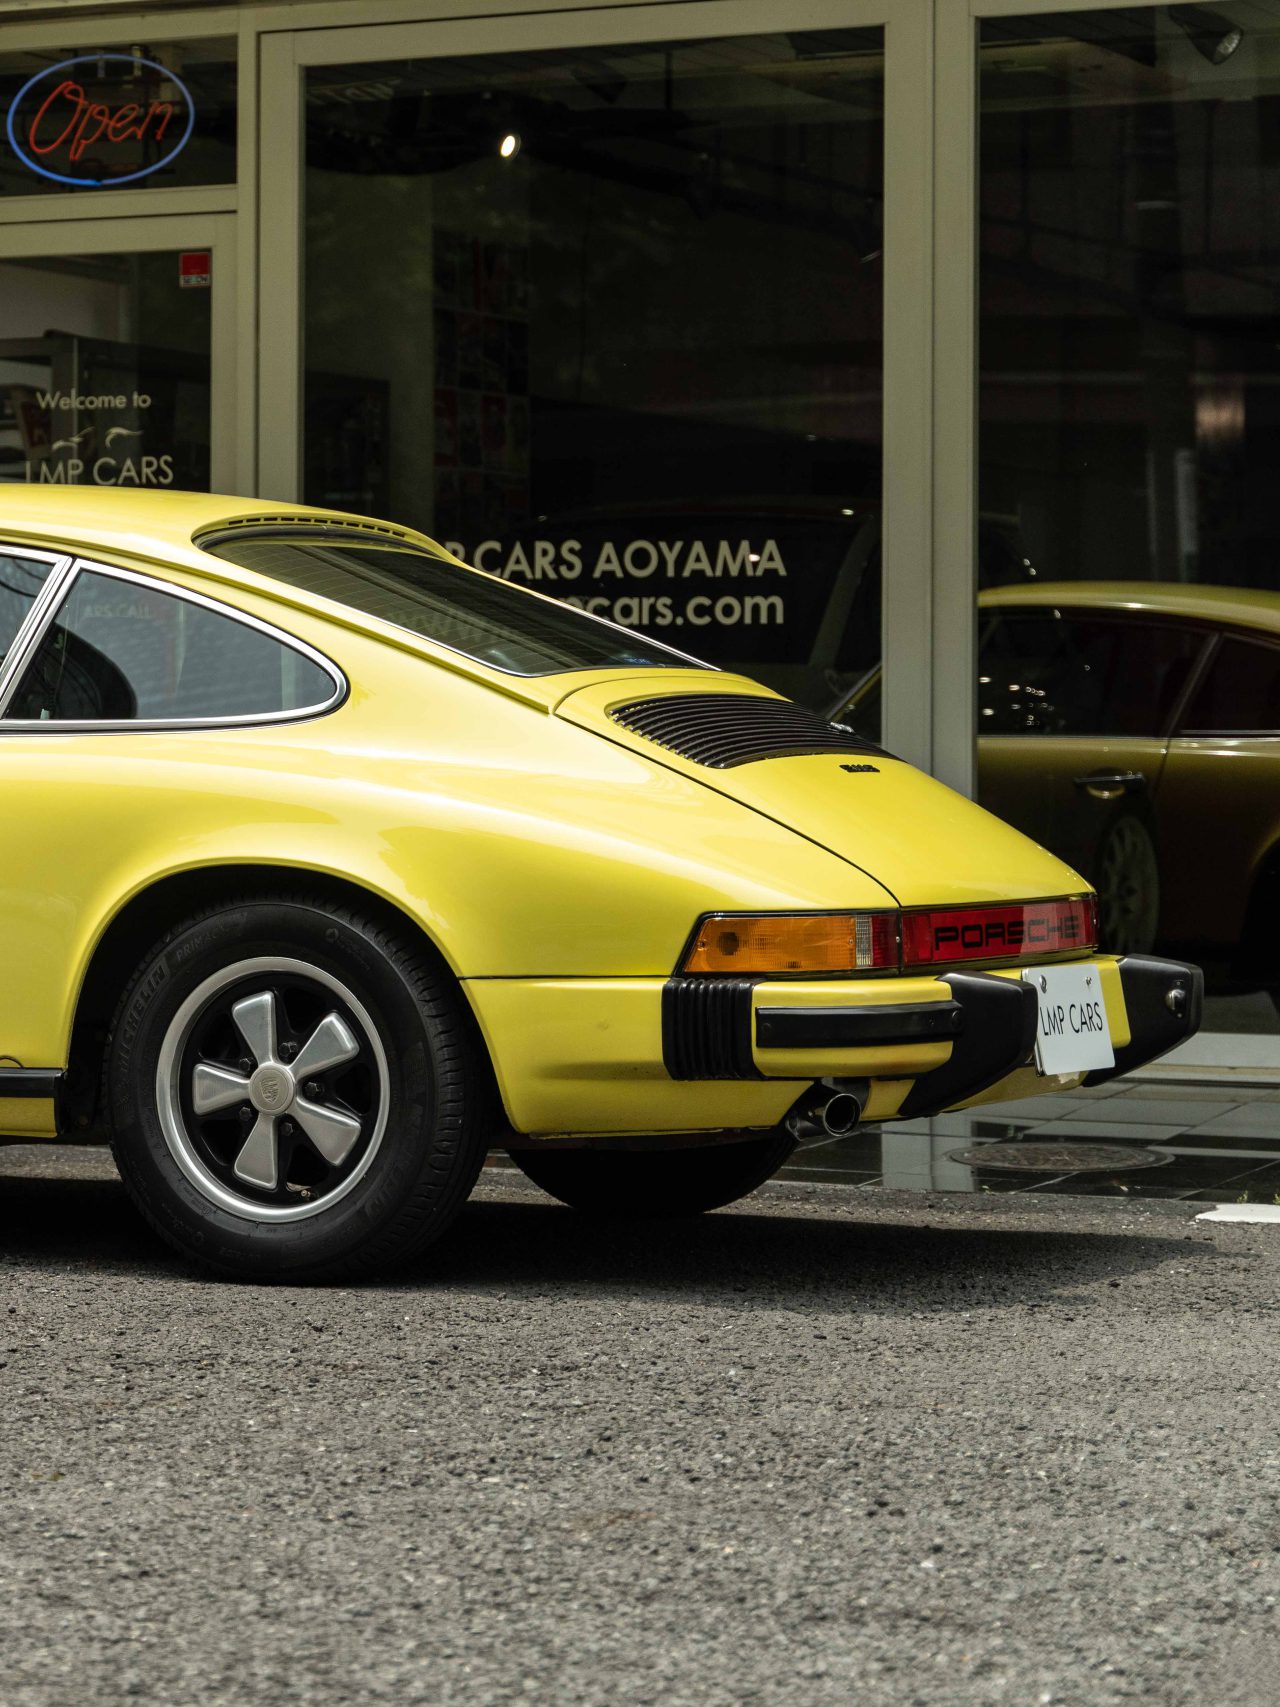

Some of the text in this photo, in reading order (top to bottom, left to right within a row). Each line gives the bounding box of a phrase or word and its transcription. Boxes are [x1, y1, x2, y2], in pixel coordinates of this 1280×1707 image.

[29, 81, 173, 160] Open
[36, 388, 152, 410] Welcome to
[92, 455, 174, 486] CARS
[473, 540, 583, 580] CARS
[592, 539, 788, 579] AOYAMA
[558, 595, 784, 627] cars.com
[934, 915, 1079, 950] PORSCHE
[1039, 1001, 1104, 1036] LMP CARS
